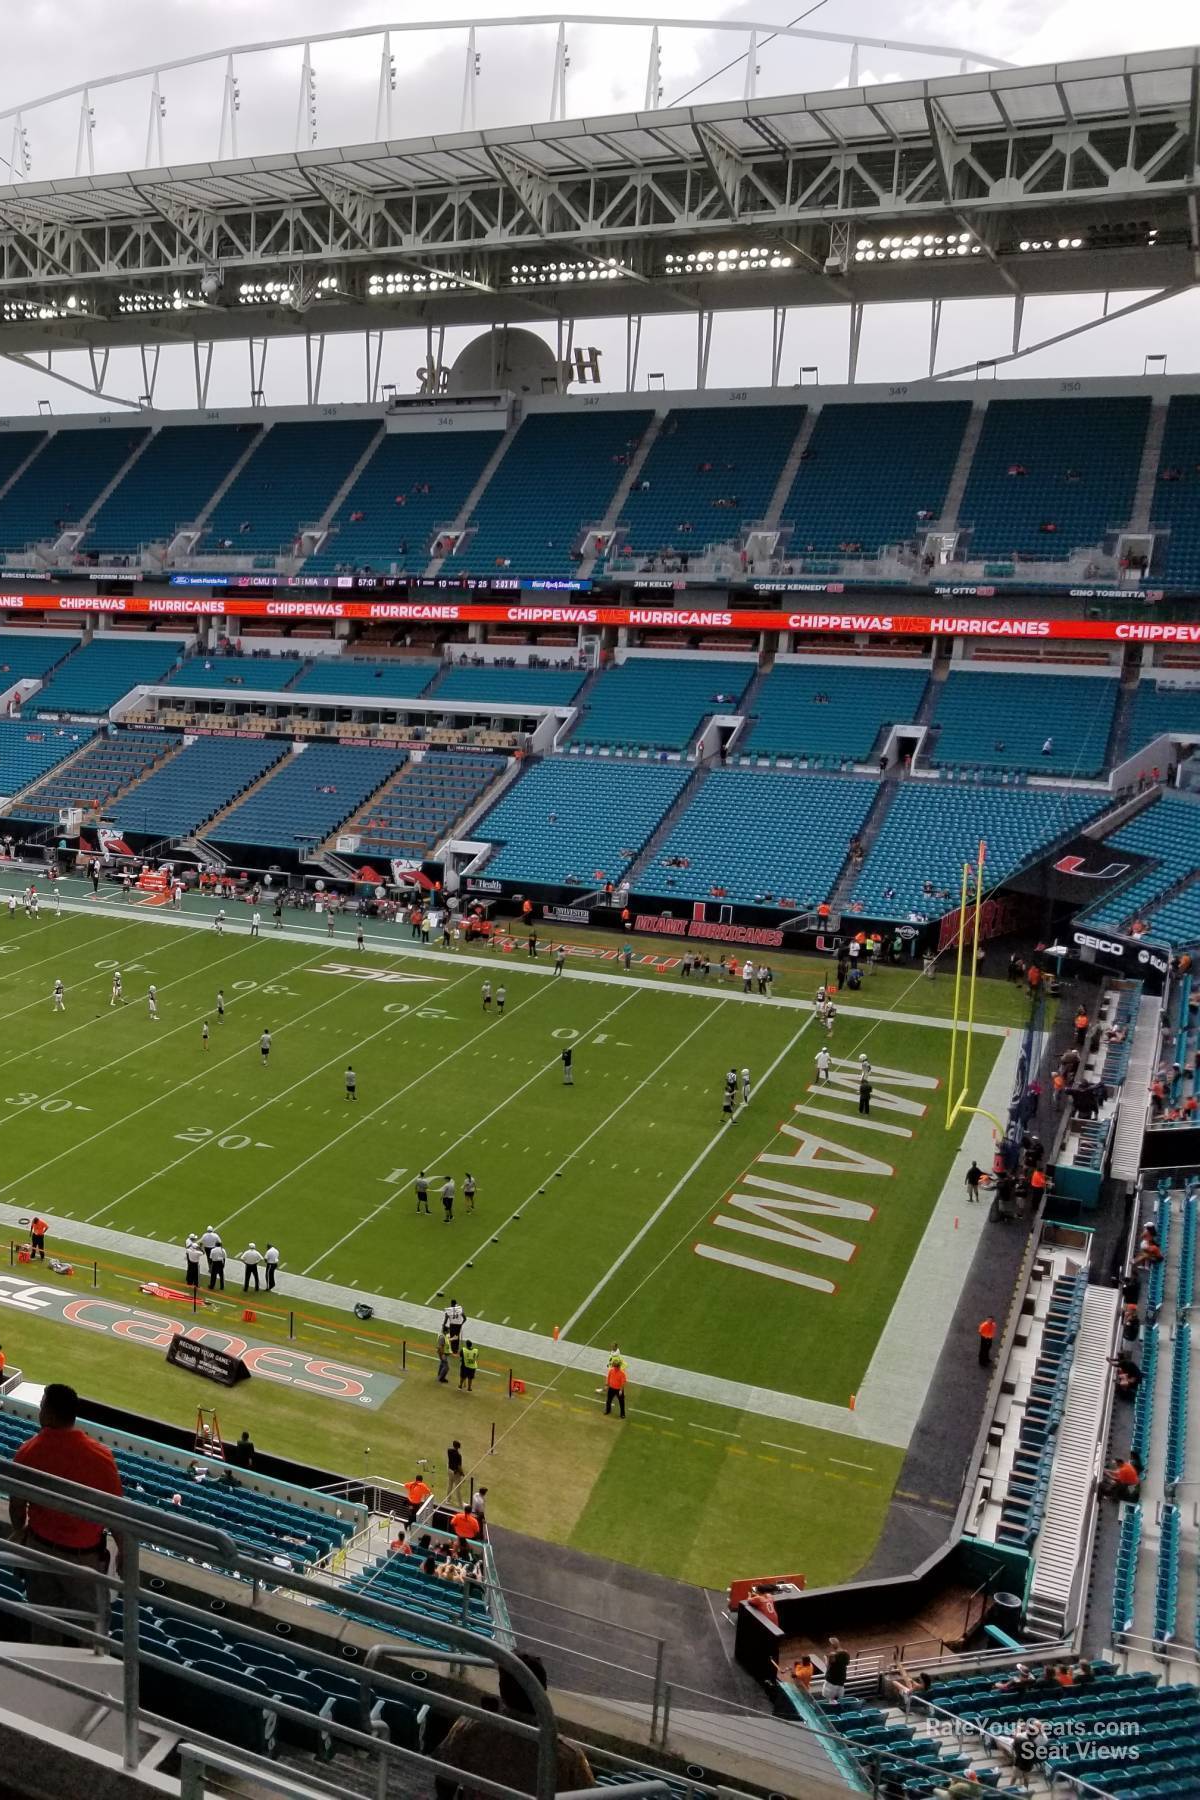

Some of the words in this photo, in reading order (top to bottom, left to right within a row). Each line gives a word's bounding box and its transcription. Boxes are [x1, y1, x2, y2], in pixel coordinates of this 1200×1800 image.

[1060, 382, 1081, 392] 350
[322, 407, 337, 416] 345
[438, 417, 454, 426] 346
[753, 583, 786, 591] CORTEZ
[1070, 589, 1094, 597] GINO
[59, 598, 126, 610] CHIPPEWAS
[149, 600, 225, 613] HURRICANES
[266, 603, 343, 615] CHIPPEWAS
[371, 605, 459, 618] HURRICANES
[507, 608, 597, 622] CHIPPEWAS
[629, 611, 732, 625] HURRICANES
[788, 615, 893, 630] CHIPPEWAS
[930, 619, 1050, 635] HURRICANES
[634, 915, 688, 937] MIAMI
[688, 920, 785, 947] HURRICANES
[1074, 932, 1124, 956] GEICO
[5, 1092, 73, 1113] 30
[174, 1127, 252, 1150] 20
[693, 1056, 944, 1297] MIAMI
[179, 1341, 201, 1353] RECOVER
[201, 1349, 215, 1359] YOUR
